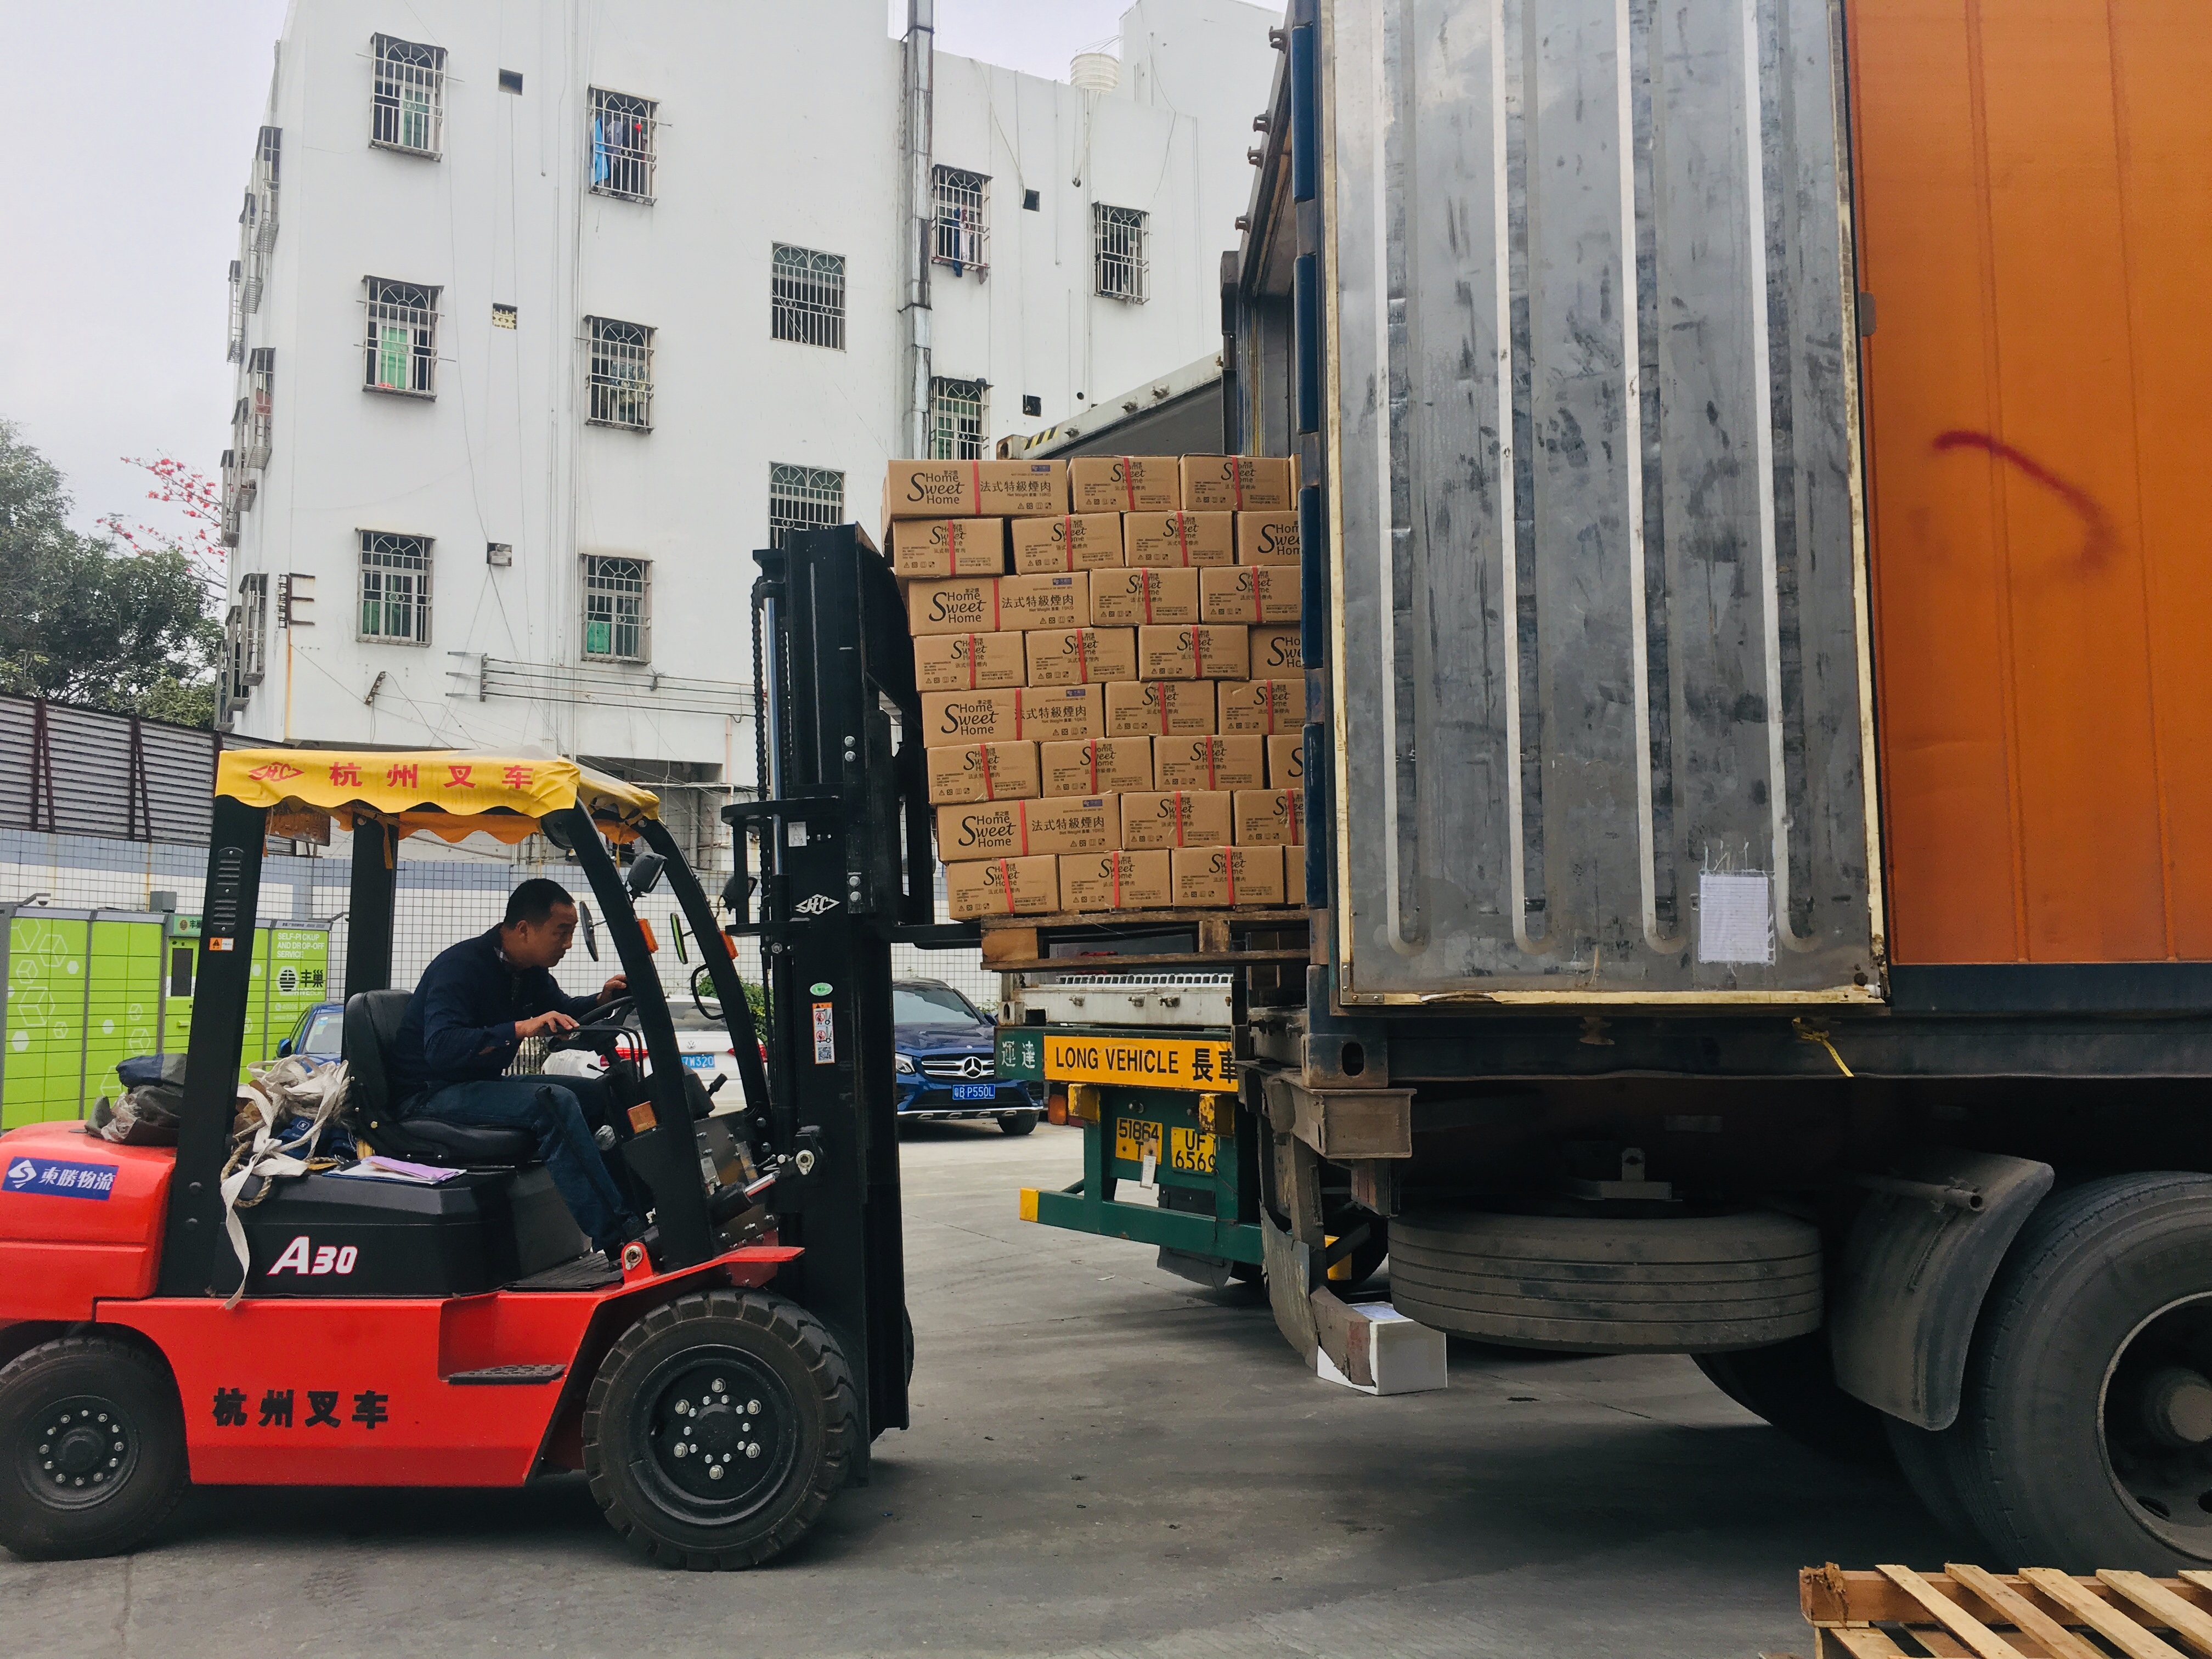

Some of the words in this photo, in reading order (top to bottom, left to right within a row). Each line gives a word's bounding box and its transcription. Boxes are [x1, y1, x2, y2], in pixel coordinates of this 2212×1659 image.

[926, 473, 958, 482] Home
[1111, 464, 1146, 482] Seet
[1221, 462, 1256, 480] Seet
[907, 473, 965, 501] Sweet
[980, 481, 1051, 492] 法式特級煙肉
[927, 495, 960, 504] Home
[929, 526, 967, 544] Swet
[1052, 523, 1087, 541] Seet
[1126, 575, 1163, 594] Swet
[1236, 573, 1272, 591] Swet
[947, 592, 980, 601] Home
[1002, 594, 1073, 608] 法式特級煙肉
[929, 592, 986, 621] Sweet
[949, 614, 981, 623] Home
[951, 641, 987, 659] Swet
[1142, 687, 1179, 705] Swet
[1254, 686, 1290, 705] Seet
[960, 704, 993, 713] Home
[941, 703, 999, 733] Sweet
[961, 726, 994, 735] Home
[963, 751, 1000, 770] Swet
[1080, 746, 1116, 765] Seet
[329, 761, 534, 789] 杭州叉车
[1158, 799, 1194, 817] Swet
[1273, 796, 1304, 815] See
[977, 815, 1009, 825] Home
[1031, 817, 1104, 832] 法式特級煙肉
[958, 816, 1016, 846] Sweet
[978, 838, 1012, 847] Home
[1209, 854, 1246, 873] Swet
[984, 866, 1020, 885] Swet
[301, 969, 324, 988] 丰巢
[1056, 1047, 1098, 1069] LONG
[1105, 1048, 1178, 1074] VEHICLE
[1119, 1119, 1159, 1143] 51864
[1186, 1131, 1207, 1150] UF
[1136, 1141, 1144, 1159] T
[38, 1166, 116, 1190] 東勝物流
[266, 1235, 358, 1275] A30
[212, 1387, 388, 1430] 杭州叉车
